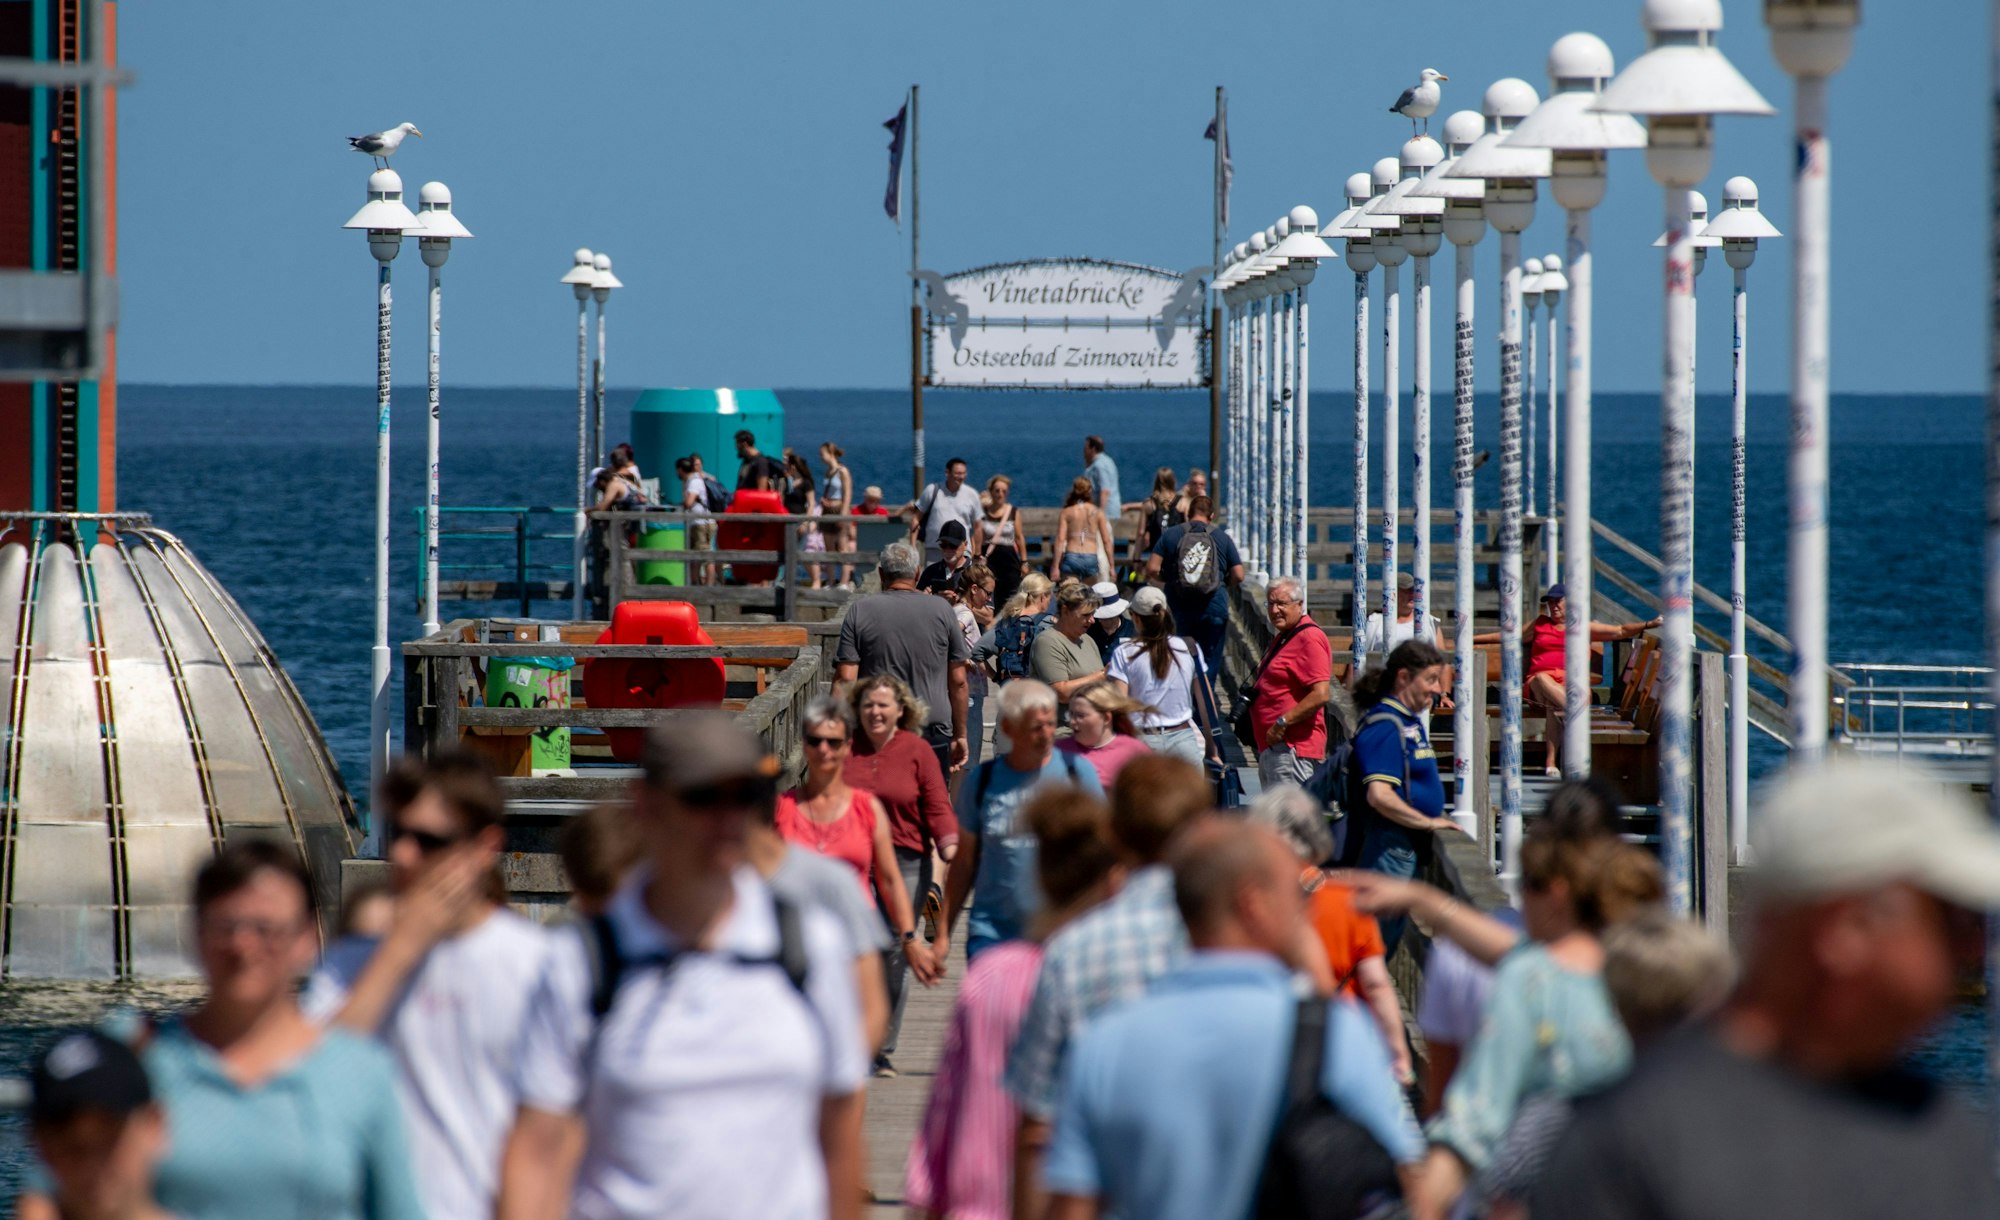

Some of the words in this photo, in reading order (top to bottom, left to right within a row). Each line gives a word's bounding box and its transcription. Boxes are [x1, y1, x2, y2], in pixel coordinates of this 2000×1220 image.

[983, 277, 1143, 310] Vinetabrücke
[953, 344, 1062, 367] Ostseebad
[1064, 347, 1178, 374] Zinnowitz
